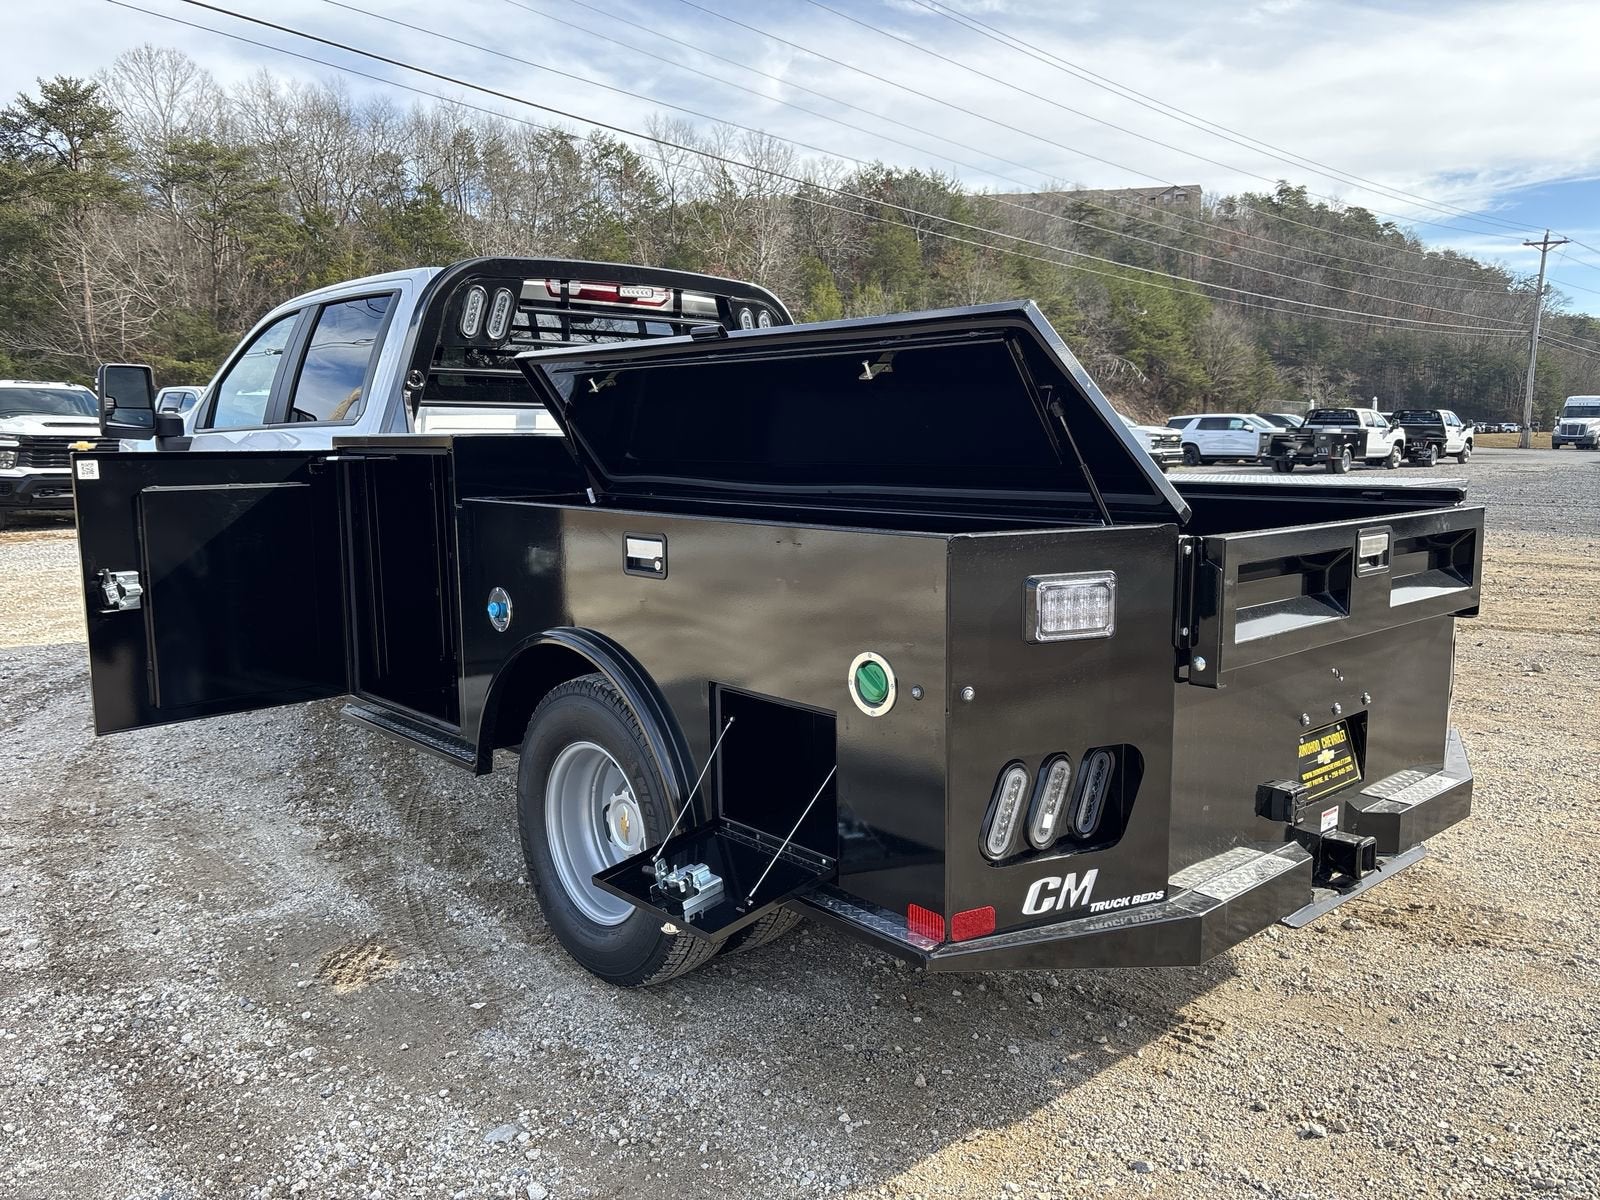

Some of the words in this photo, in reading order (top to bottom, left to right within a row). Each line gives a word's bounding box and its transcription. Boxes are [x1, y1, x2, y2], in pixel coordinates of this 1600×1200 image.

[1321, 730, 1346, 748] CHEVROLET
[1022, 868, 1100, 915] CM
[1090, 896, 1131, 913] TRUCK
[1131, 890, 1165, 905] BEDS
